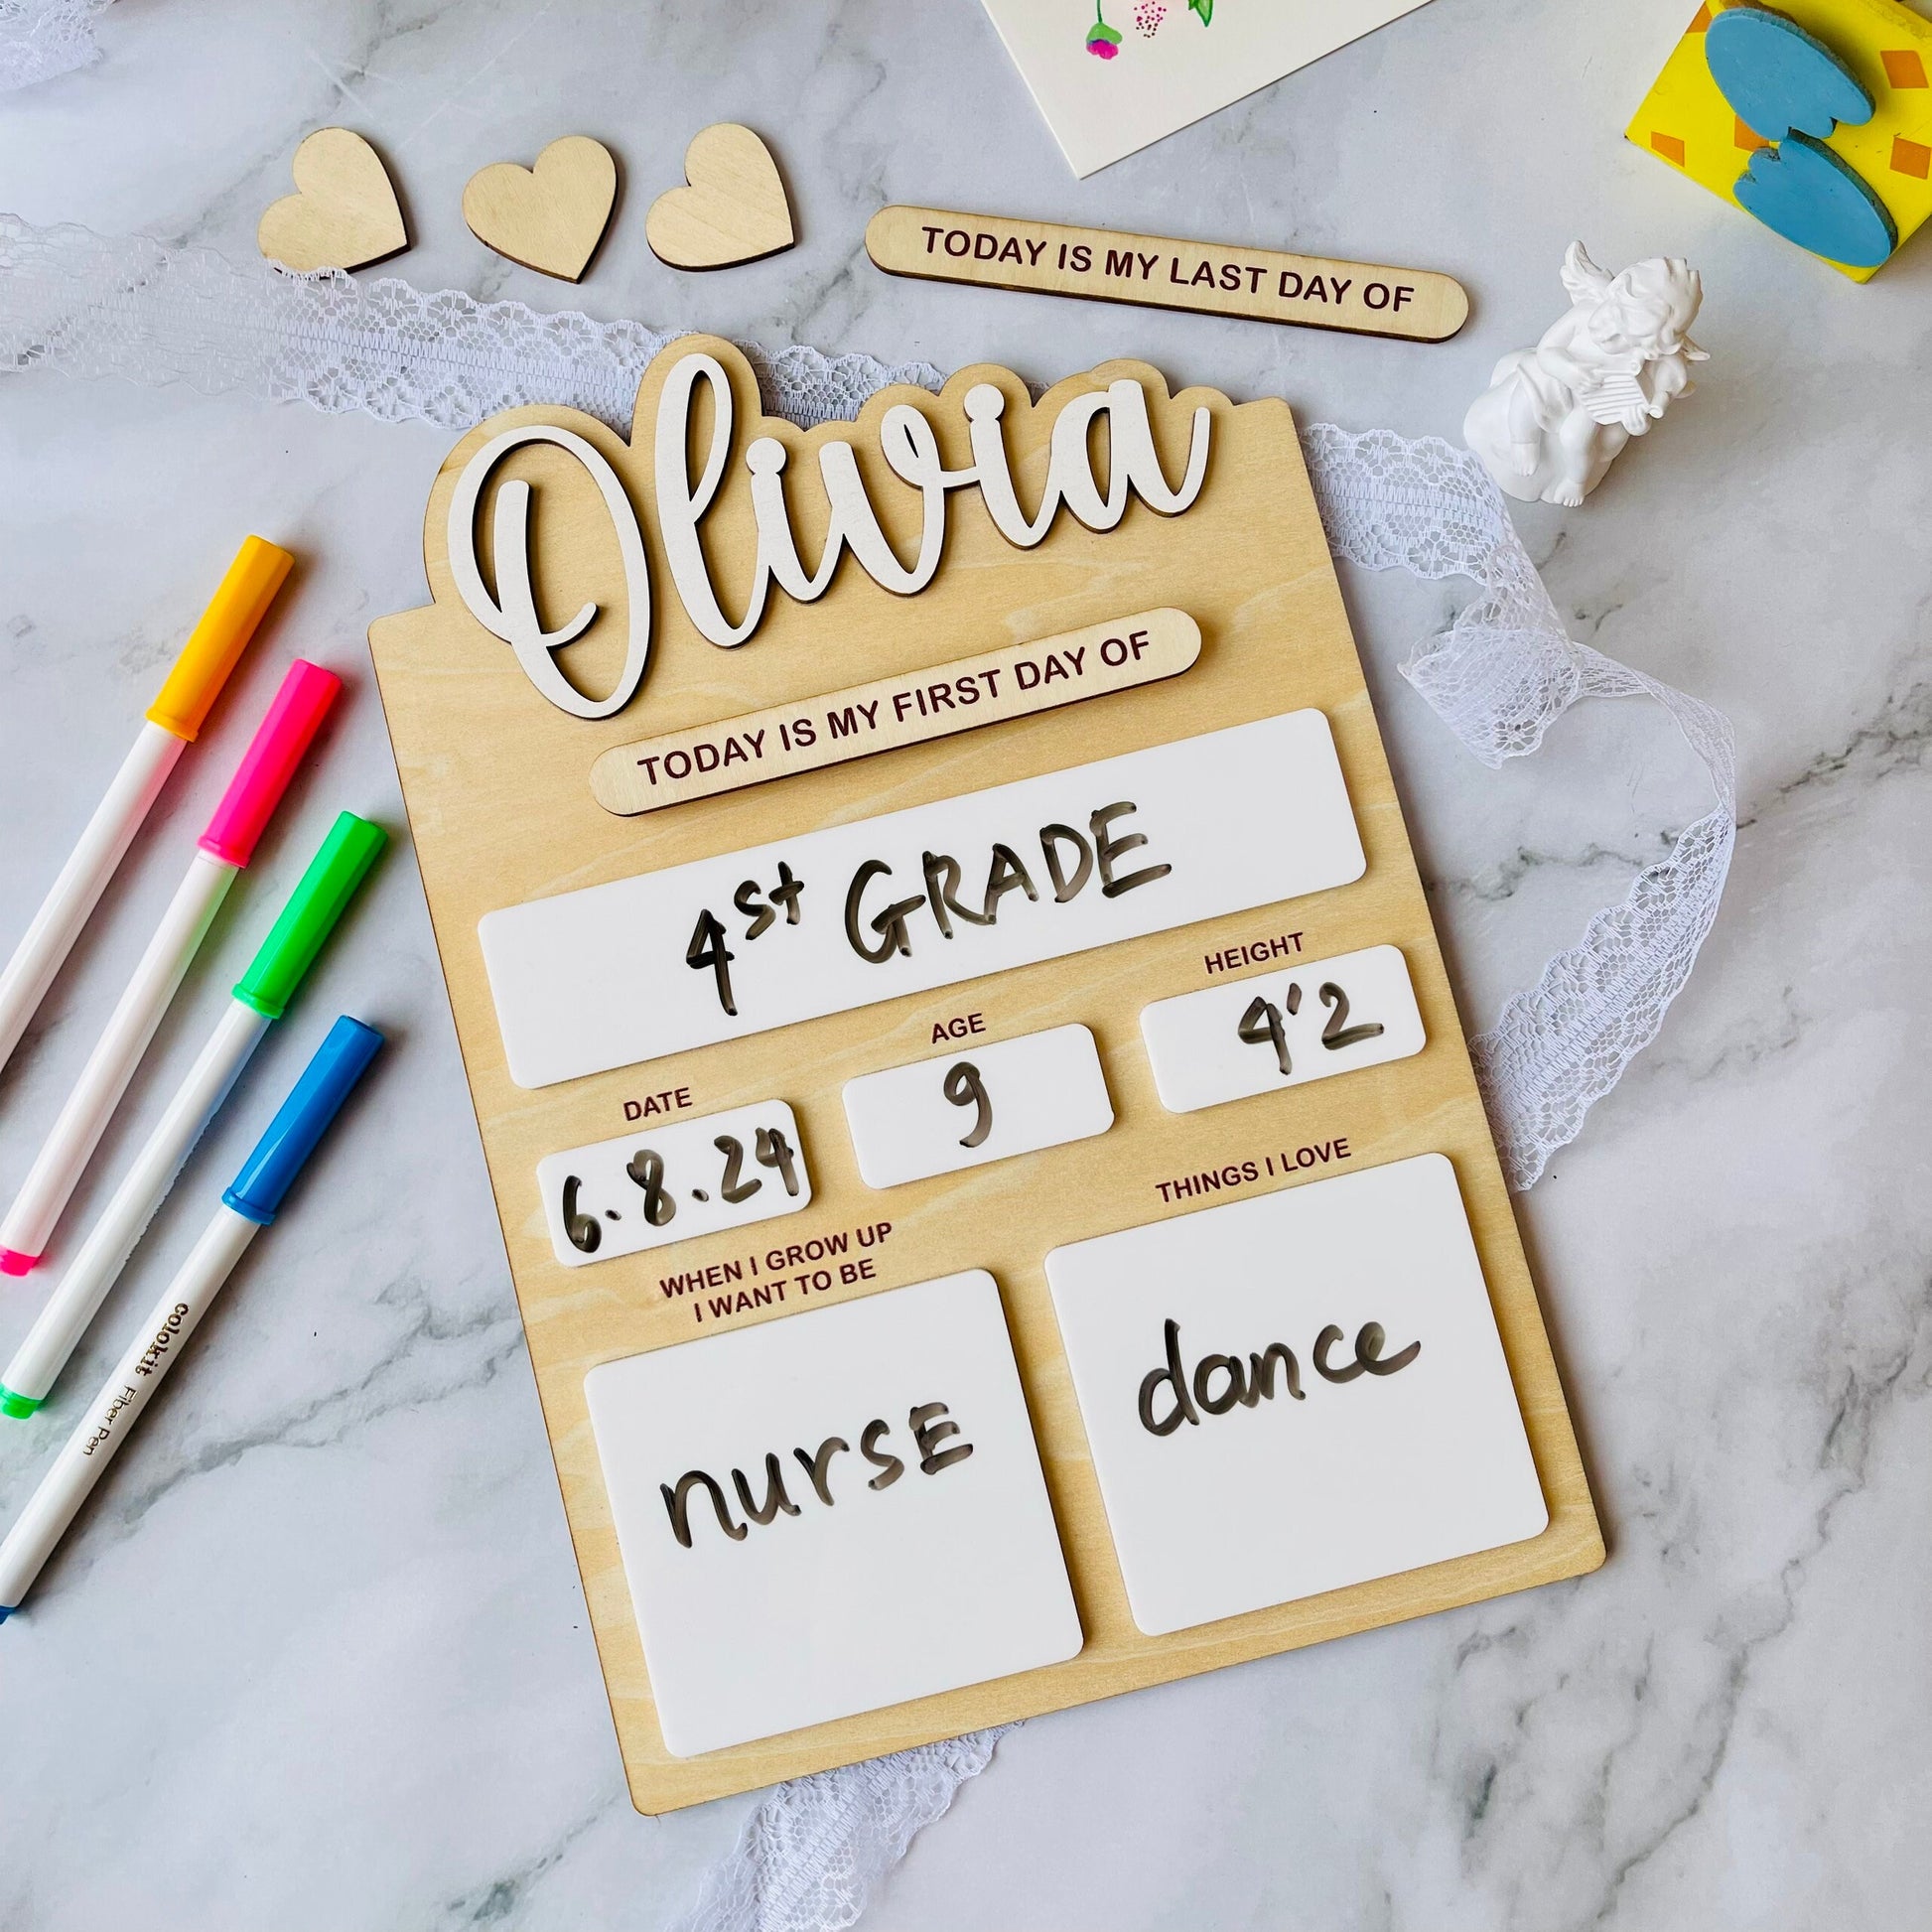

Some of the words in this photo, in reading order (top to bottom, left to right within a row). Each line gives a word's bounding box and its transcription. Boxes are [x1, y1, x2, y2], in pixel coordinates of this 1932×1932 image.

[921, 226, 1047, 267] TODAY
[1057, 243, 1092, 273] IS
[1105, 249, 1160, 280] MY
[1170, 256, 1268, 294] LAST
[1278, 271, 1352, 305] DAY
[1363, 282, 1415, 313] OF
[448, 352, 1211, 719] Olivia
[636, 729, 766, 785] TODAY
[778, 718, 817, 752] IS
[826, 700, 879, 740] MY
[892, 668, 1004, 723] FIRST
[1014, 645, 1086, 691] DAY
[1100, 629, 1150, 667] OF
[685, 861, 805, 1017] 4st
[844, 801, 1173, 964] GRADE
[1204, 931, 1304, 975] HEIGHT
[931, 1013, 987, 1044] AGE
[622, 1086, 693, 1122] DATE
[943, 1061, 993, 1149] 9
[1155, 1161, 1259, 1203] THINGS
[1265, 1157, 1275, 1176] I
[1280, 1137, 1352, 1173] LOVE
[659, 1260, 744, 1299] WHEN
[749, 1256, 759, 1277] I
[765, 1232, 849, 1271] GROW
[856, 1222, 893, 1246] UP
[694, 1303, 703, 1323] I
[706, 1276, 787, 1318] WANT
[793, 1270, 832, 1296] TO
[839, 1258, 877, 1286] BE
[135, 1303, 189, 1376] colokit
[104, 1385, 137, 1426] Fiber
[1138, 1317, 1422, 1437] dance
[83, 1426, 111, 1455] Pen
